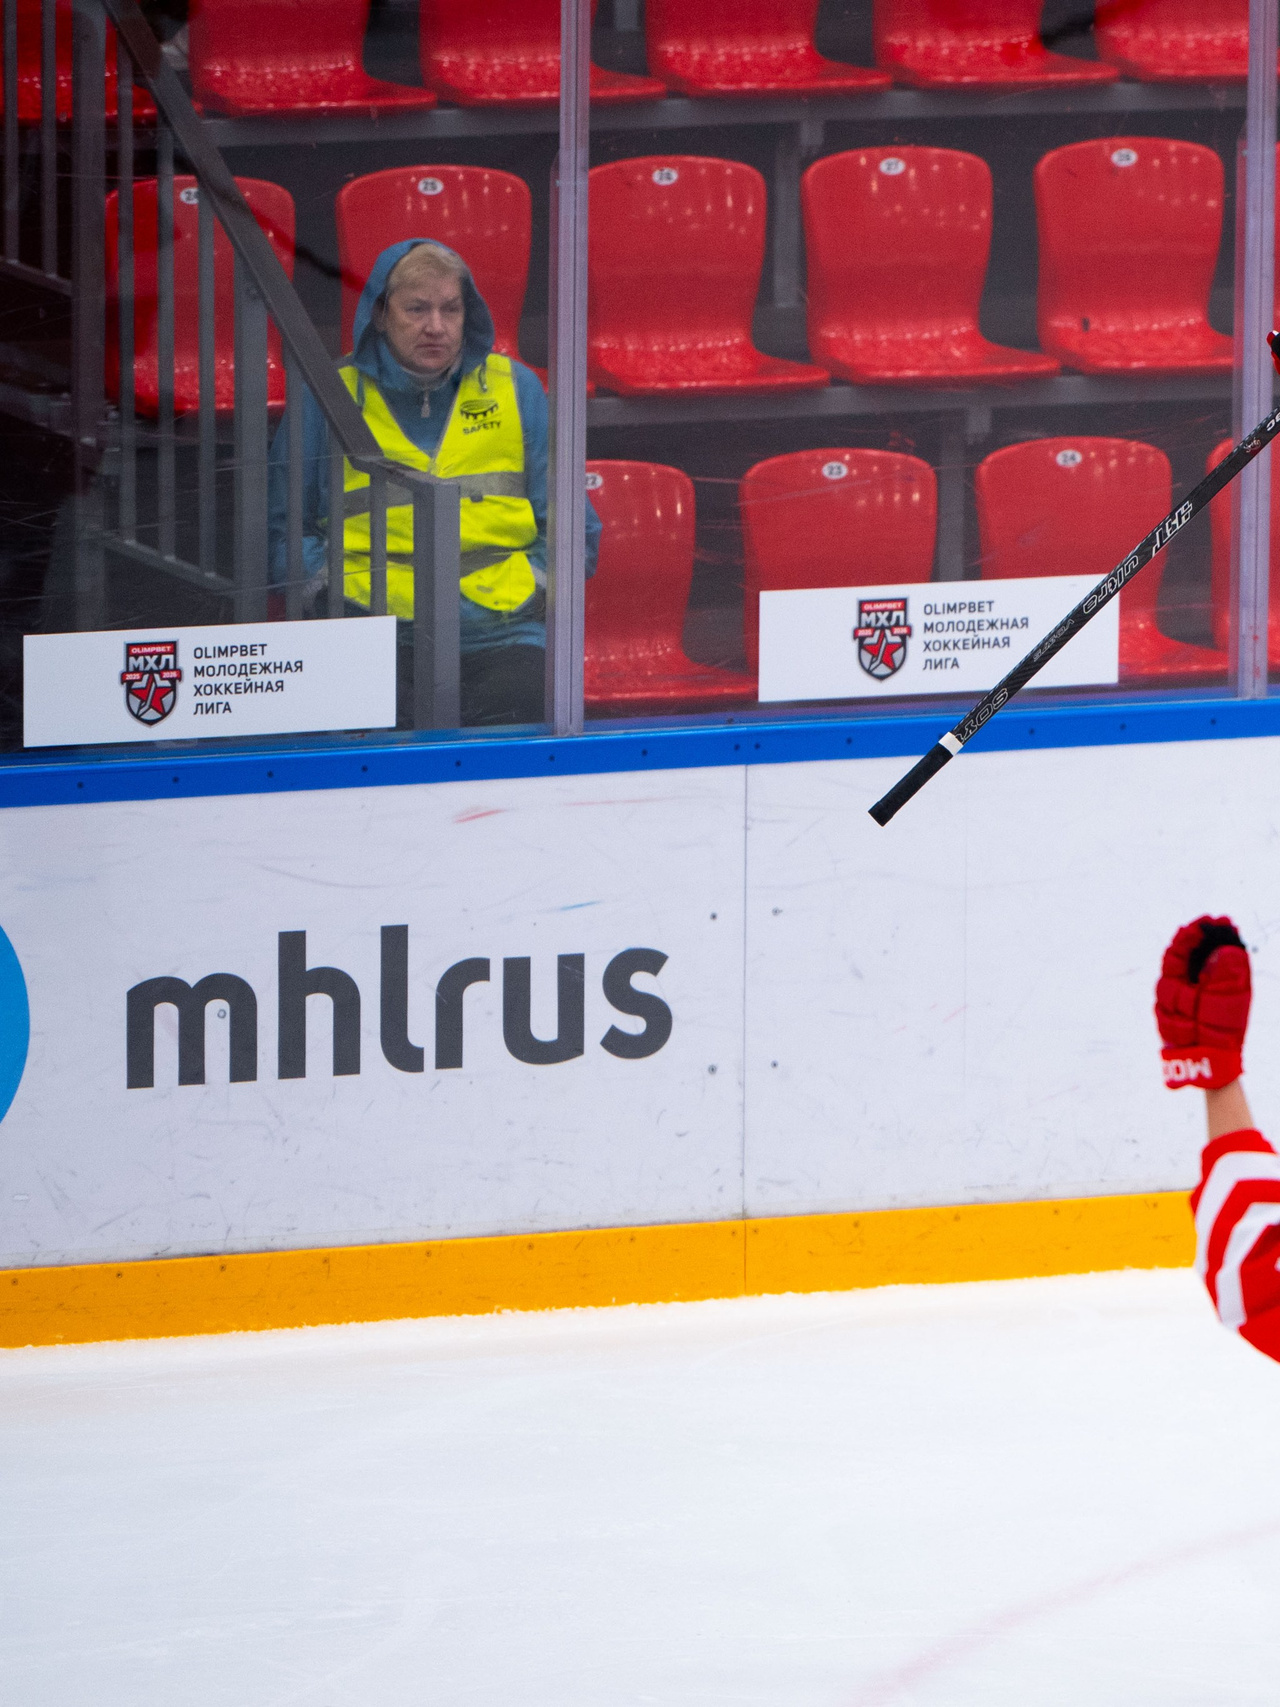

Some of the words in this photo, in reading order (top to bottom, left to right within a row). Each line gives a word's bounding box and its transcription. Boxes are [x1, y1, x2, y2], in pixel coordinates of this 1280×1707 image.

[923, 600, 995, 615] OLIMPBET
[861, 611, 905, 628] МХЛ
[923, 617, 1029, 634] МОЛОДЕЖНАЯ
[131, 645, 172, 654] OLIMPBET
[193, 643, 268, 660] OLIMPBET
[923, 635, 1011, 652] ХОККЕЙНАЯ
[128, 654, 175, 672] МХЛ
[193, 660, 304, 679] МОЛОДЕЖНАЯ
[922, 657, 960, 671] ЛИГА
[193, 679, 285, 697] ХОККЕЙНАЯ
[193, 701, 232, 715] ЛИГА
[127, 924, 673, 1089] mhlrus
